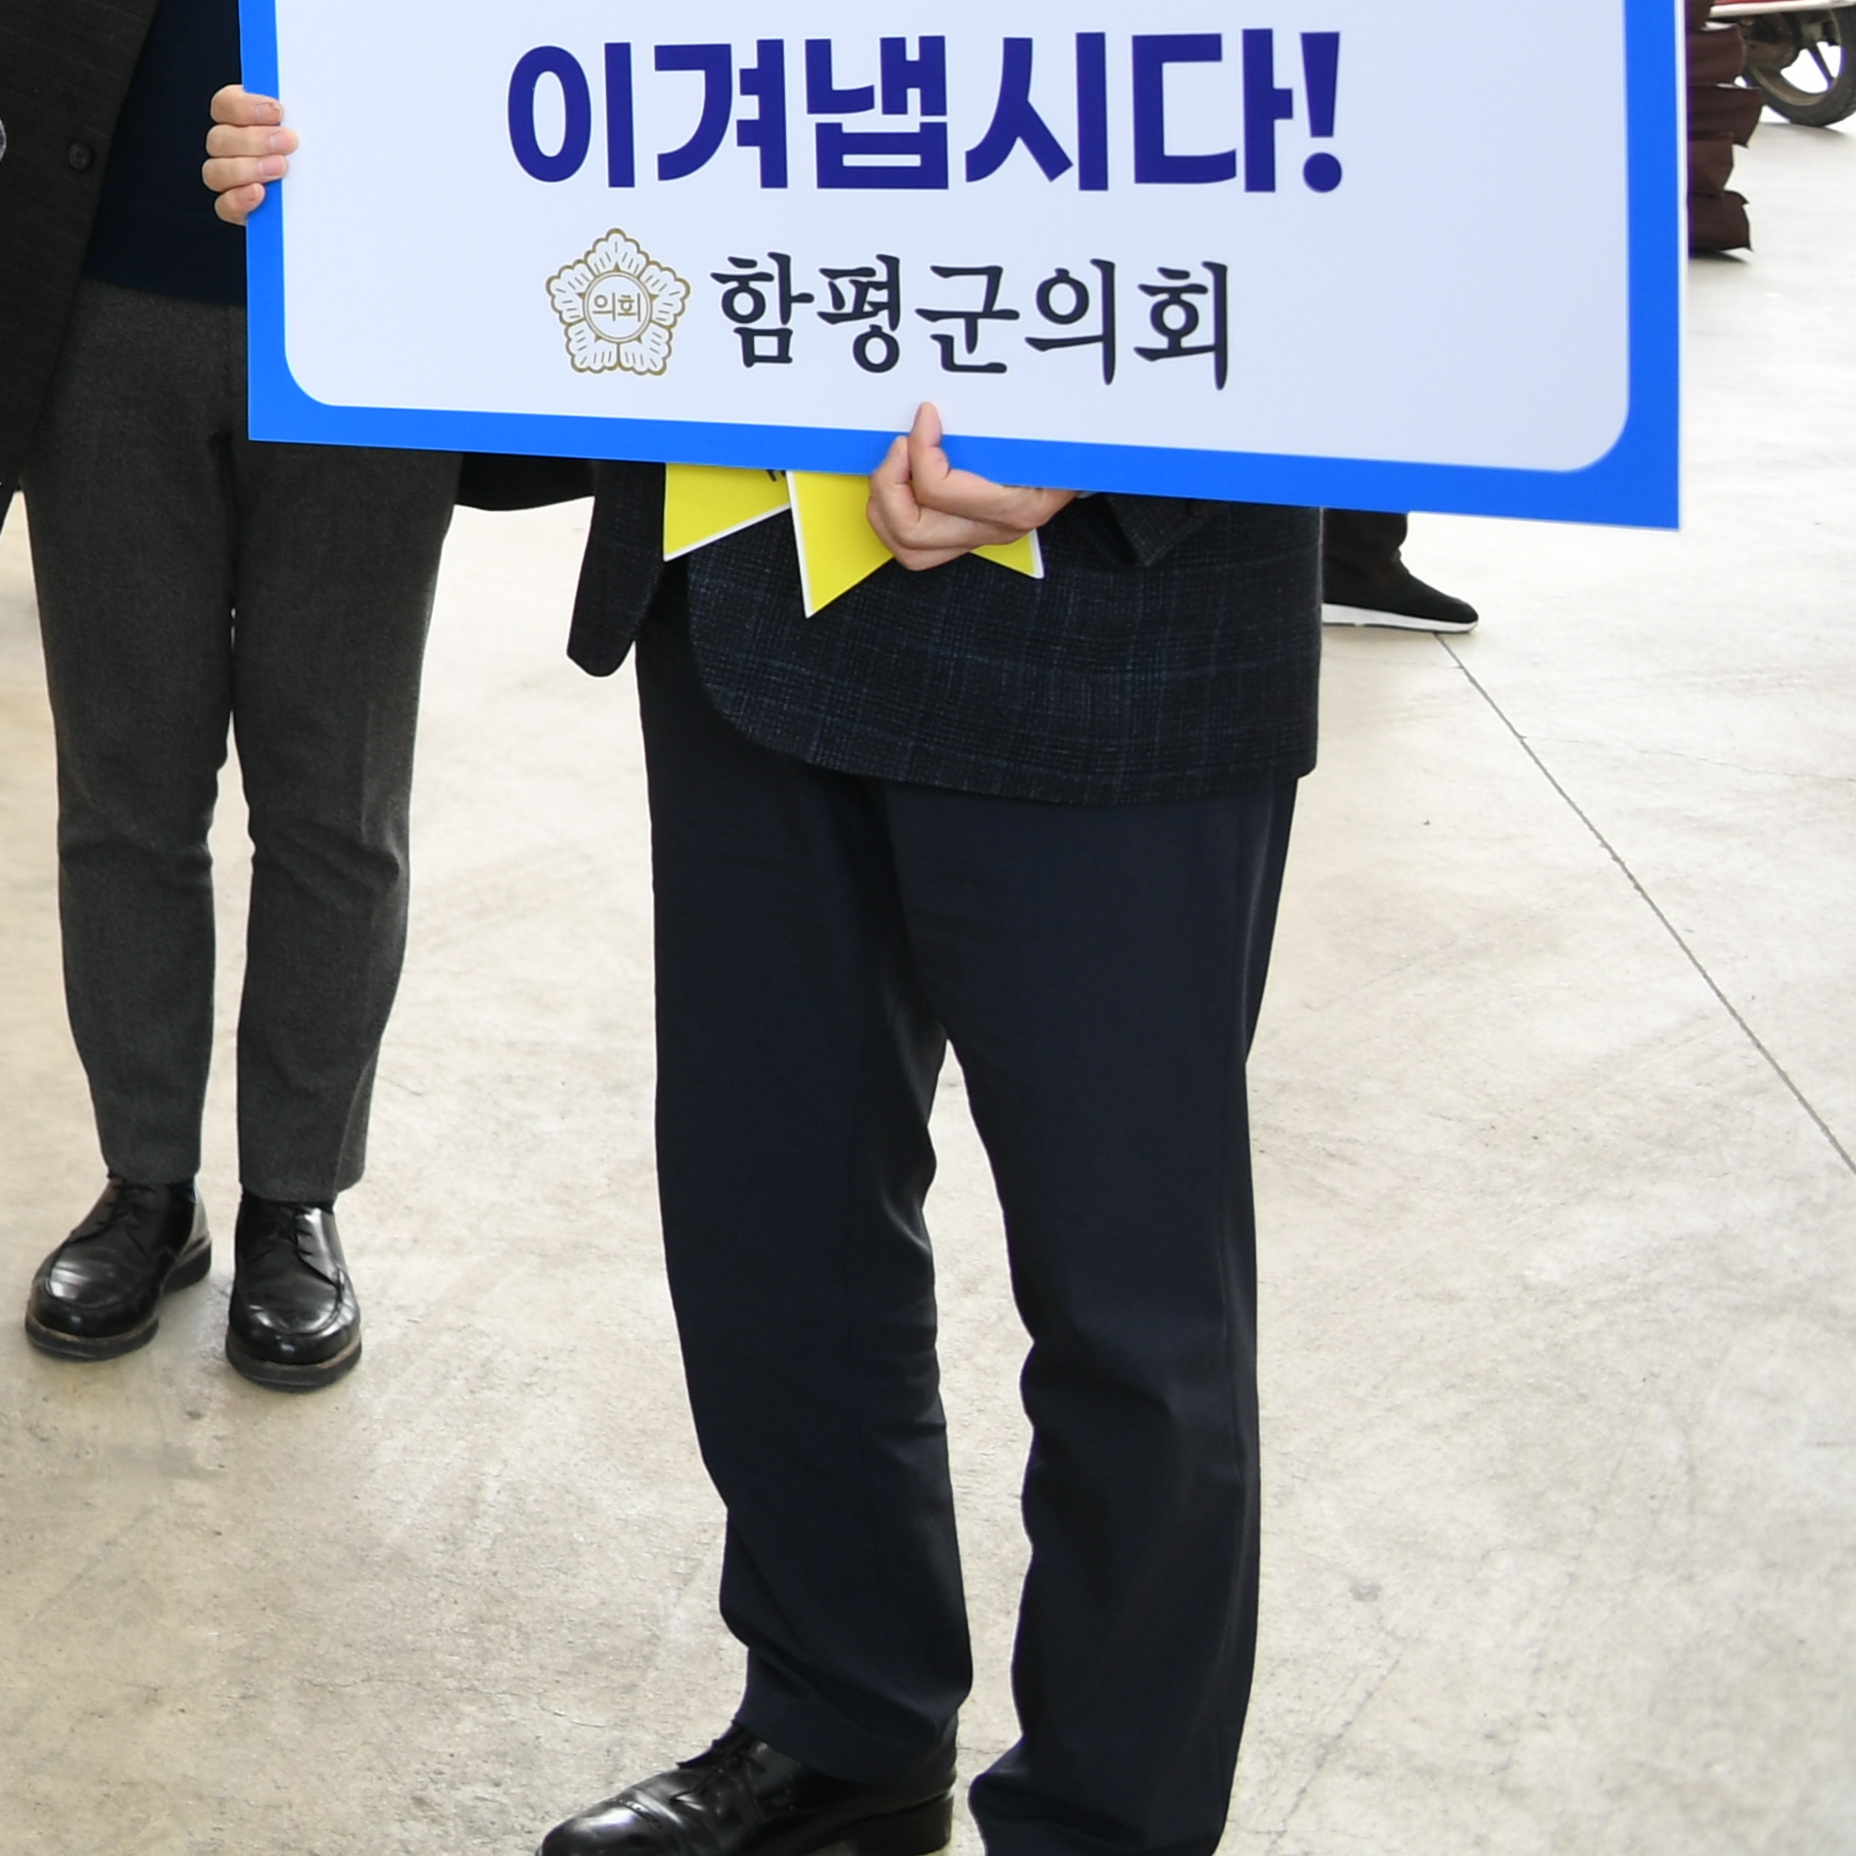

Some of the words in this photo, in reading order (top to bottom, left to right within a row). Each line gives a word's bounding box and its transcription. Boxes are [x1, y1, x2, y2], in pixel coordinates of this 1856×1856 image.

[507, 27, 1343, 194] 이겨냅시다!
[591, 287, 652, 326] 의회
[709, 251, 1231, 392] 함평군의회
